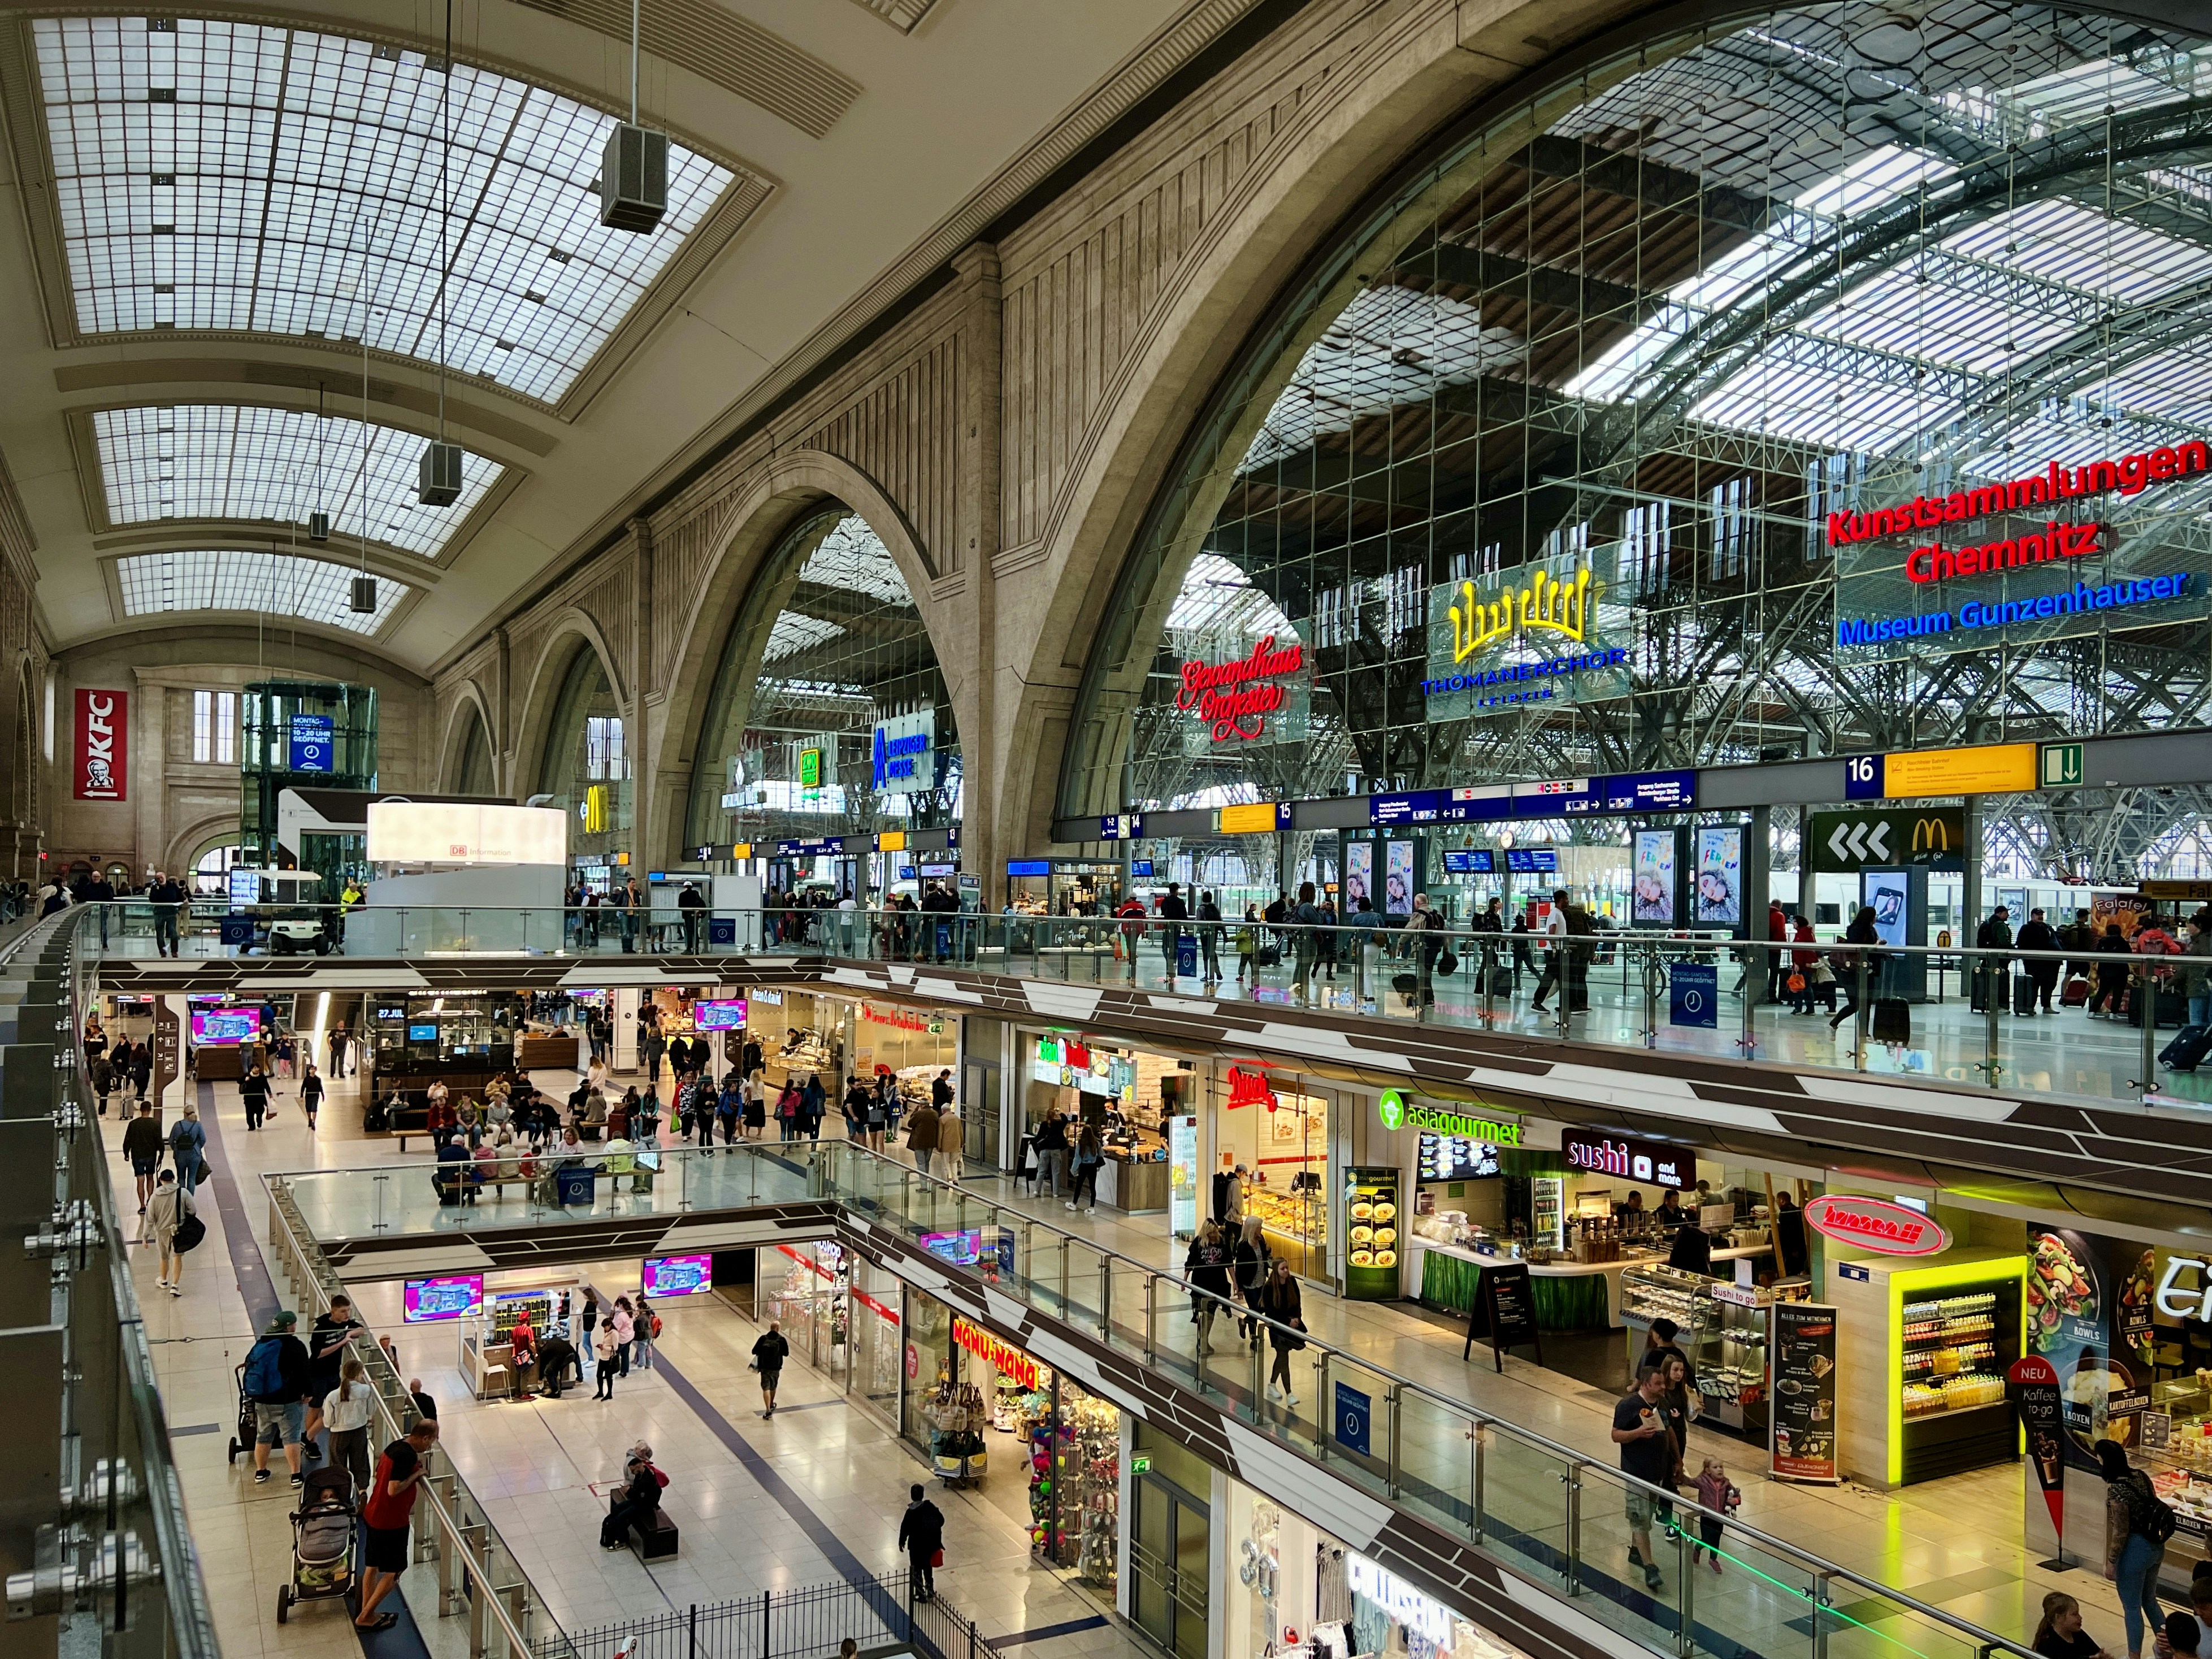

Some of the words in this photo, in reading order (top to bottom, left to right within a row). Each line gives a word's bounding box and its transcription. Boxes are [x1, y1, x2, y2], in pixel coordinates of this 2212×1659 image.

[1828, 440, 2212, 545] Kunstsammlungen
[1906, 520, 2103, 583] Chemnitz
[1838, 610, 1953, 647] Museum
[1959, 572, 2187, 628] Gunzenhauser
[1177, 635, 1304, 710] Gewandhaus
[1420, 646, 1627, 696] THOMANERCHOR
[1478, 689, 1552, 707] LEIPZIG
[88, 694, 113, 762] KFC
[888, 733, 927, 757] LEIPZIGER
[888, 758, 914, 778] MESSE
[1849, 757, 1873, 782] 16
[1280, 803, 1291, 819] 15
[1120, 818, 1127, 835] S
[1131, 814, 1140, 828] 14
[873, 833, 878, 845] 12
[949, 828, 955, 840] 13
[452, 846, 466, 855] DB
[1641, 850, 1672, 871] FERIEN
[1704, 849, 1738, 870] FERIEN
[2094, 898, 2147, 911] Falafel
[1407, 1107, 1520, 1147] asiagourmet
[1568, 1140, 1628, 1176] sushi
[1658, 1162, 1675, 1175] and
[1658, 1173, 1682, 1186] more
[1713, 1286, 1734, 1300] Sushi
[1736, 1292, 1743, 1301] to
[1745, 1296, 1755, 1305] go
[2129, 1314, 2146, 1326] BOWLS
[2074, 1326, 2100, 1341] BOWLS
[2021, 1367, 2046, 1379] NEU
[2023, 1388, 2056, 1401] Kaffee
[2028, 1402, 2053, 1418] to-go
[2109, 1395, 2149, 1412] KARTOFFELBOXEN
